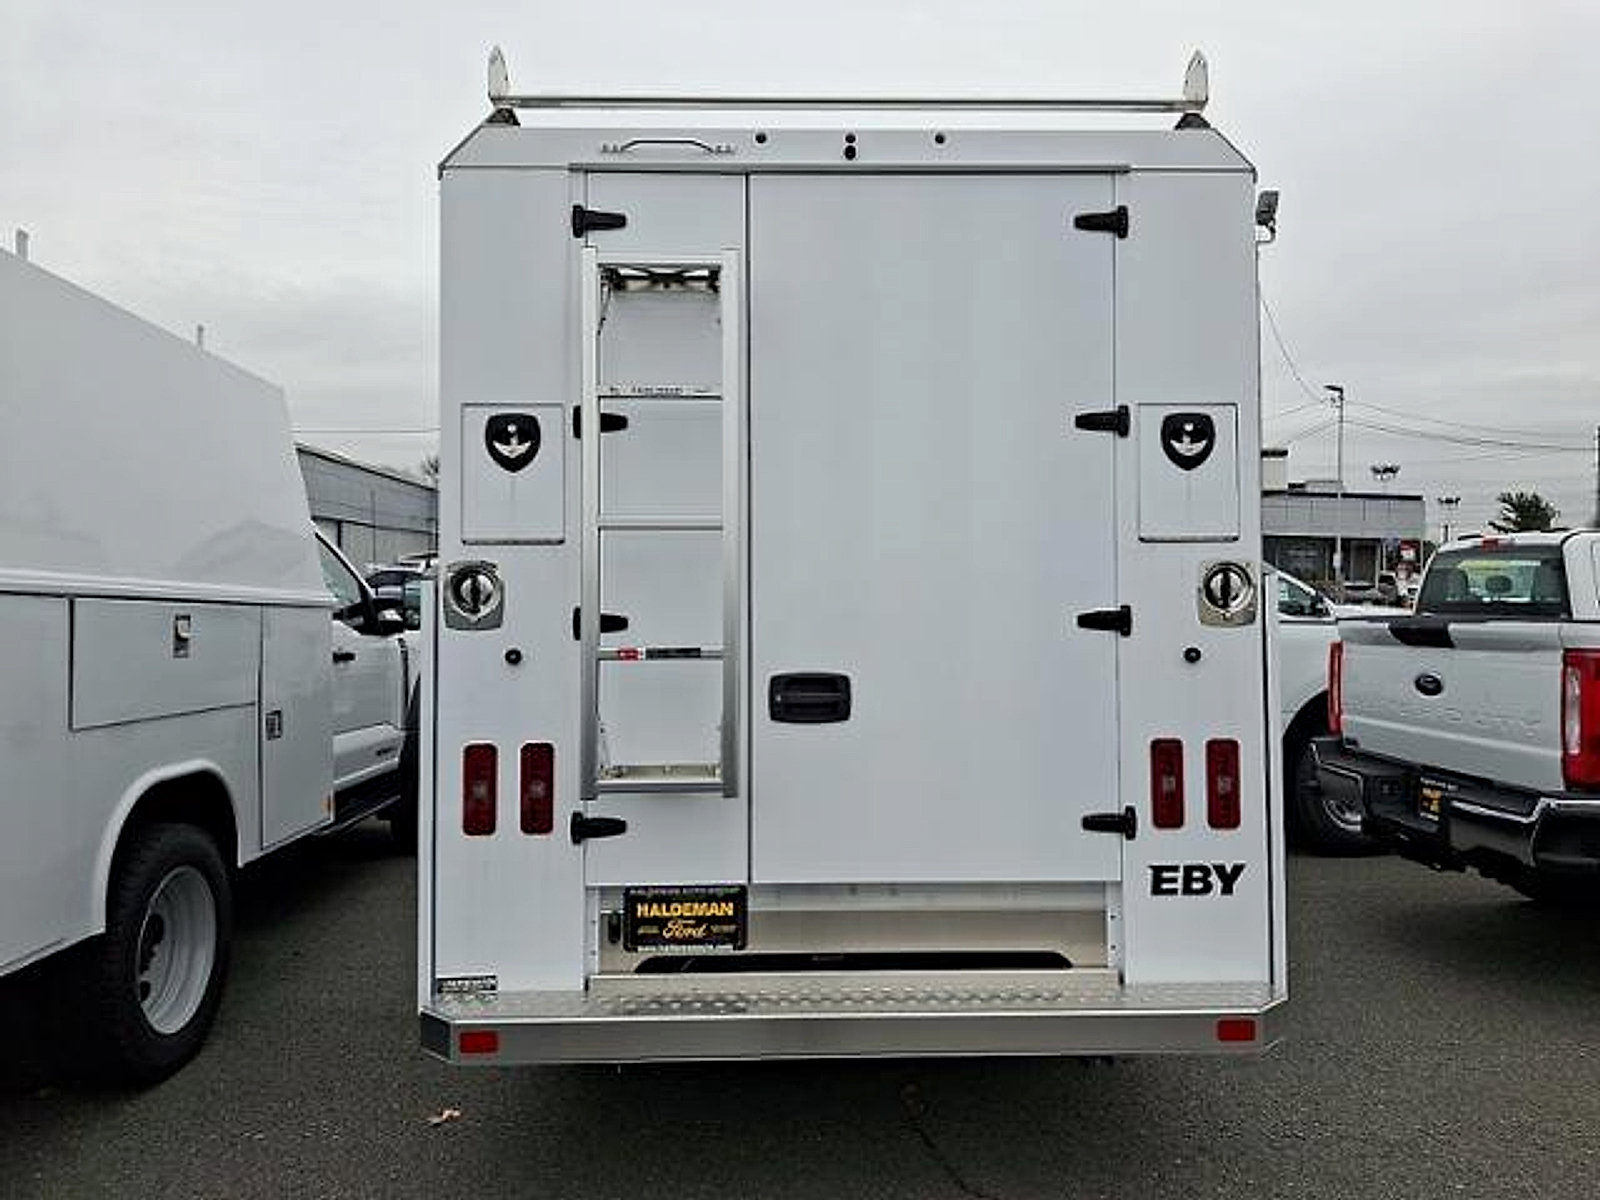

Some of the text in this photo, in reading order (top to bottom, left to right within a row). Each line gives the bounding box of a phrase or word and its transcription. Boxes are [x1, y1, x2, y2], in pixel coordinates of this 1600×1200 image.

[1147, 864, 1246, 896] EBY
[636, 902, 734, 918] HALDEMAN
[662, 919, 708, 939] Ford
